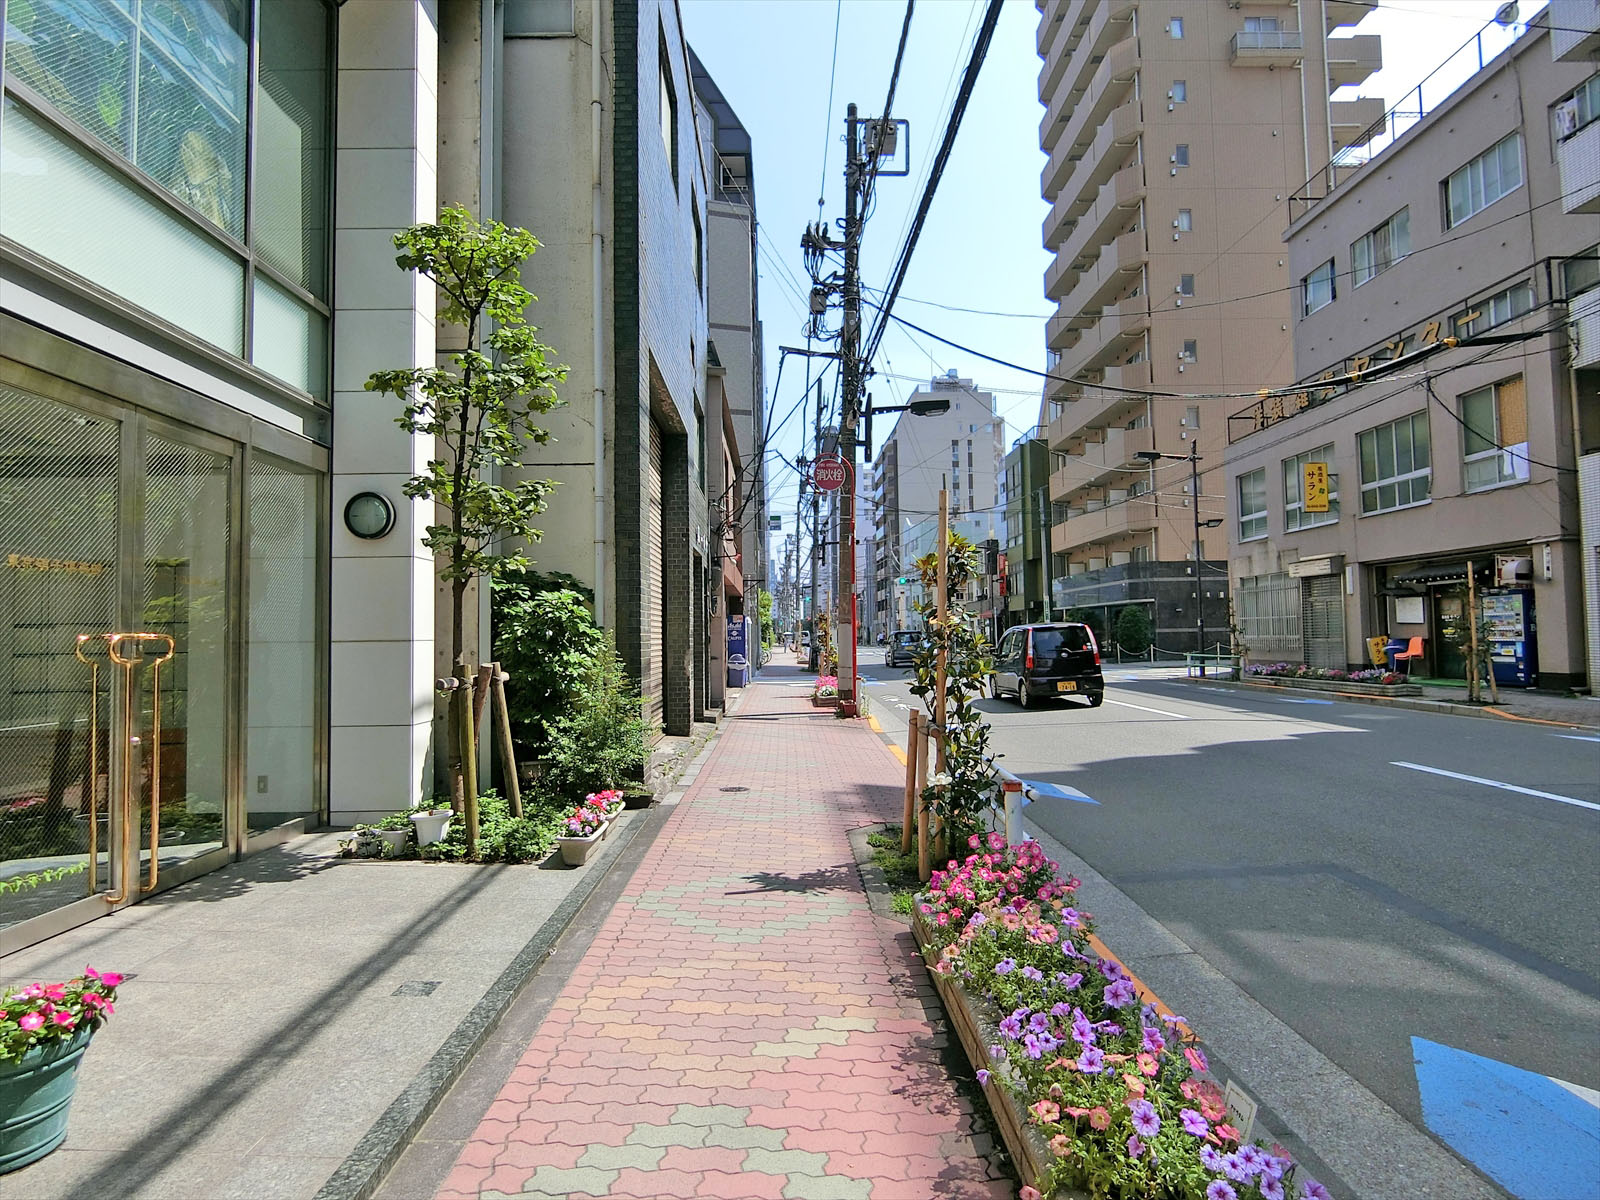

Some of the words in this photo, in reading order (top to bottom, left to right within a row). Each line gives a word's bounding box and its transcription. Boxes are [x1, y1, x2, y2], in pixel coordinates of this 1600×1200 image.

[816, 469, 843, 481] 消火栓
[1307, 470, 1316, 501] サラン
